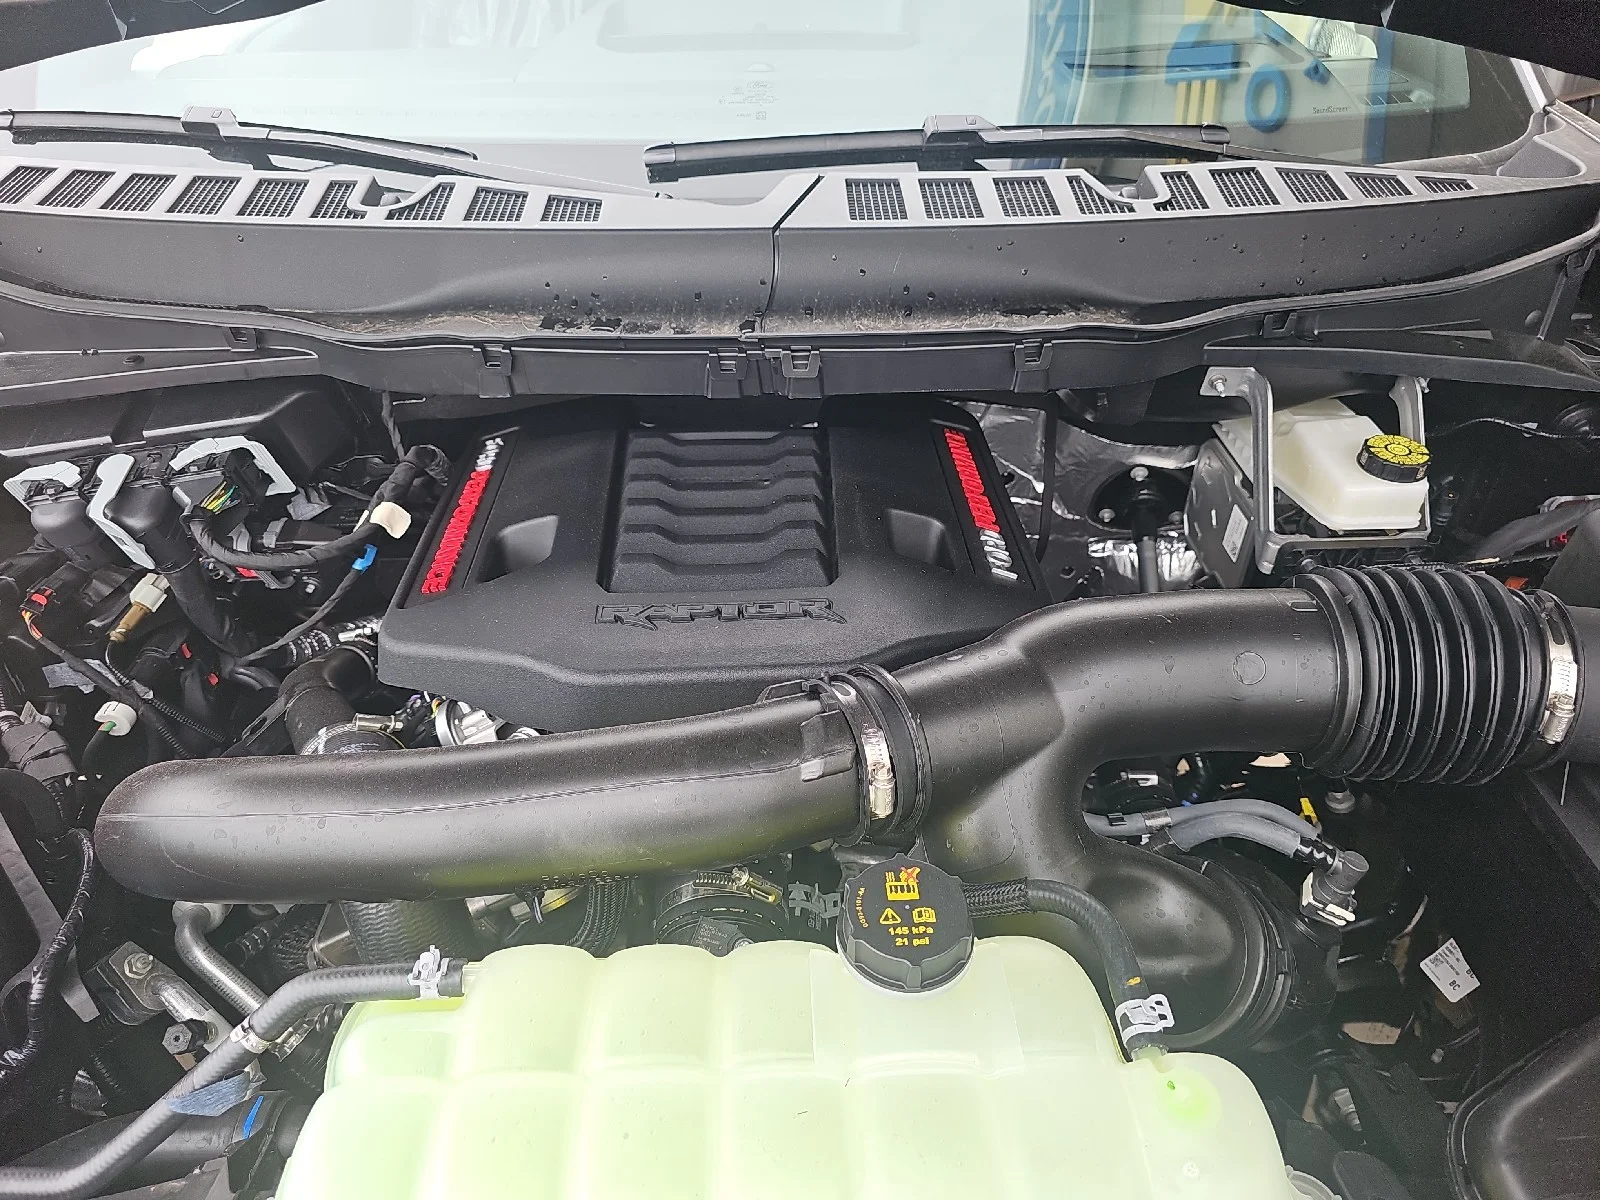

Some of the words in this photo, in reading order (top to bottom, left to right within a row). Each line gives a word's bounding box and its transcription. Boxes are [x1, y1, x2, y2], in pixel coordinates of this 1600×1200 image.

[595, 598, 847, 631] RAPTOR
[888, 927, 910, 936] 145
[911, 925, 934, 935] kPa
[895, 938, 909, 946] 21
[912, 937, 930, 947] psi
[1449, 980, 1460, 990] BC
